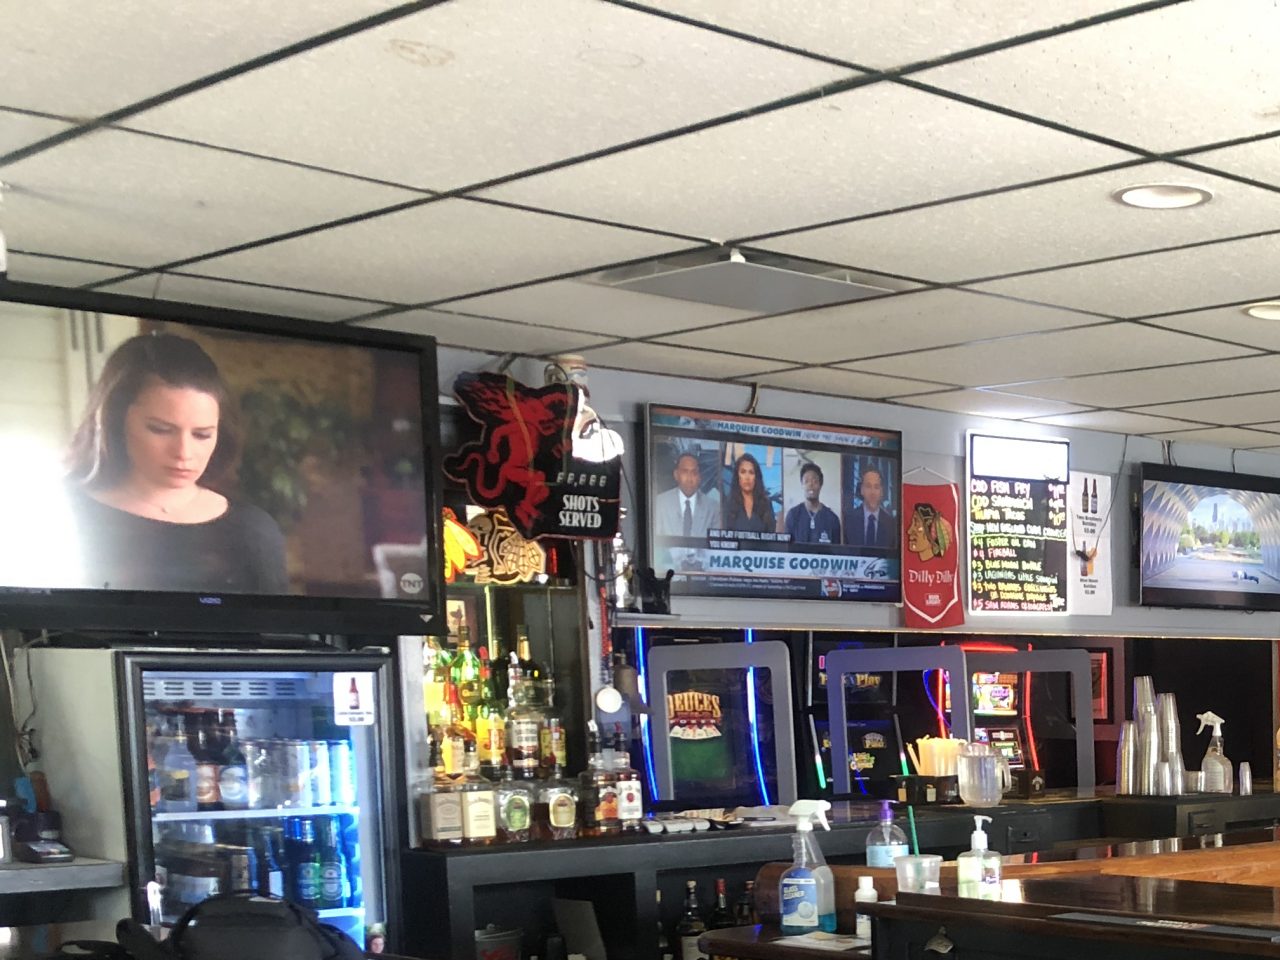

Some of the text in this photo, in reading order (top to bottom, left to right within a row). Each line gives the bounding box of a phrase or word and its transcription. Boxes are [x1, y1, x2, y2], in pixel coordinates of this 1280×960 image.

[717, 422, 801, 437] MARQUISE GOODWIN
[562, 494, 600, 512] SHOTS
[558, 510, 602, 528] SERVED
[709, 555, 859, 572] MARQUISE GOODWIN
[401, 579, 423, 588] TNT
[908, 569, 935, 587] Dilly
